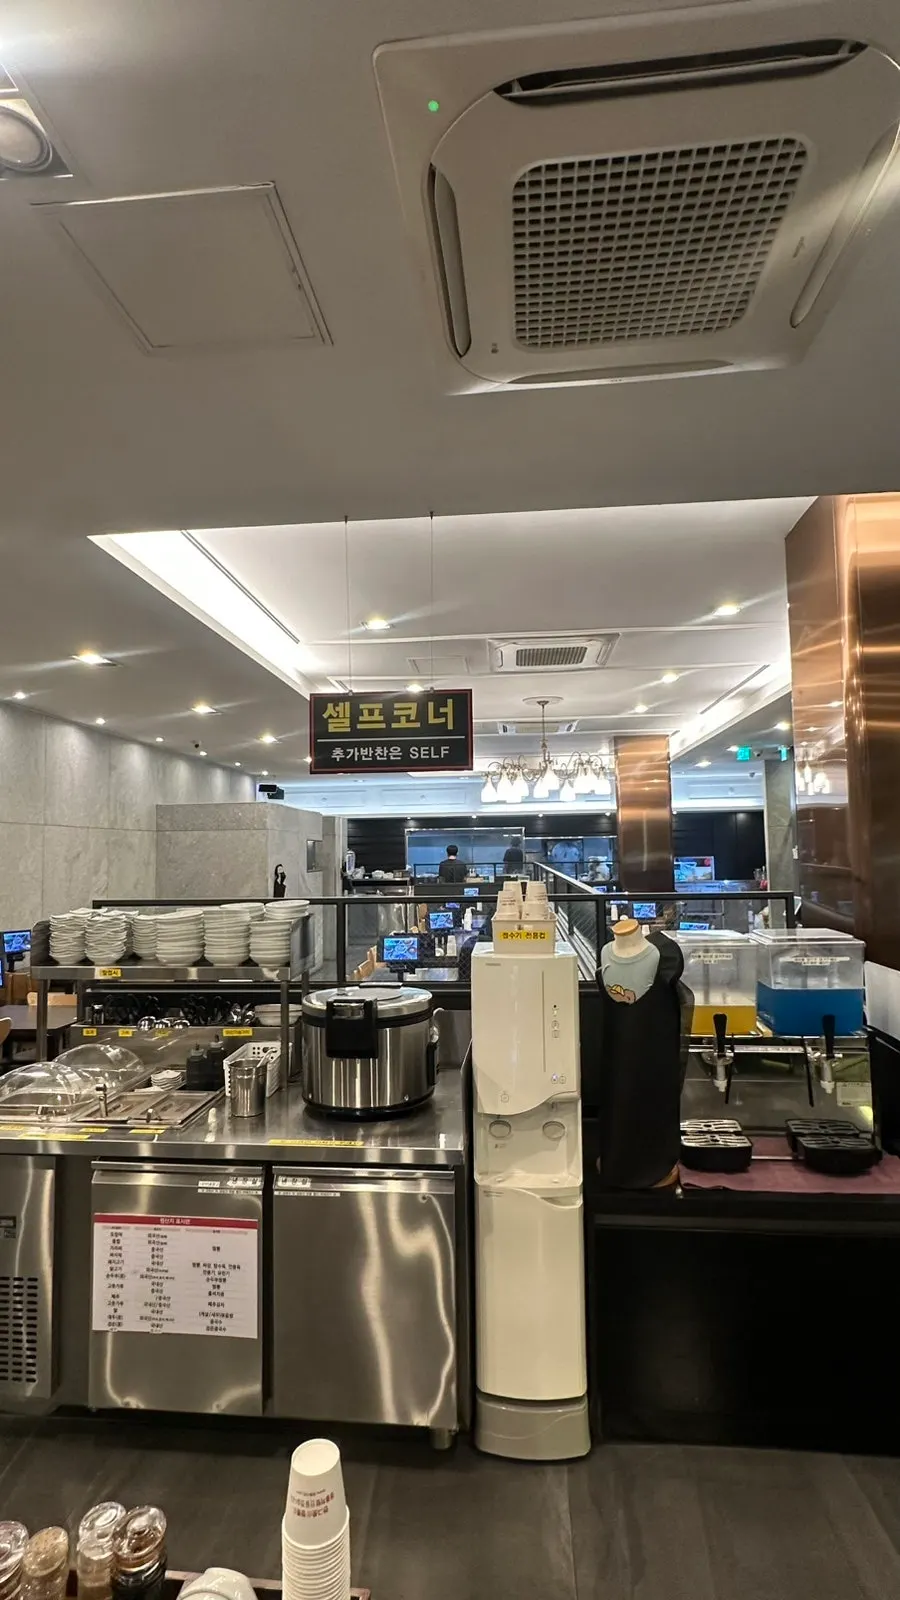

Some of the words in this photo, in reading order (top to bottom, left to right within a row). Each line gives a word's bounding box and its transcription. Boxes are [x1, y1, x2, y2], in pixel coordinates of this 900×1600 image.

[322, 698, 454, 733] 셀프코너
[331, 746, 403, 762] 추가반찬은
[409, 746, 450, 759] SELF
